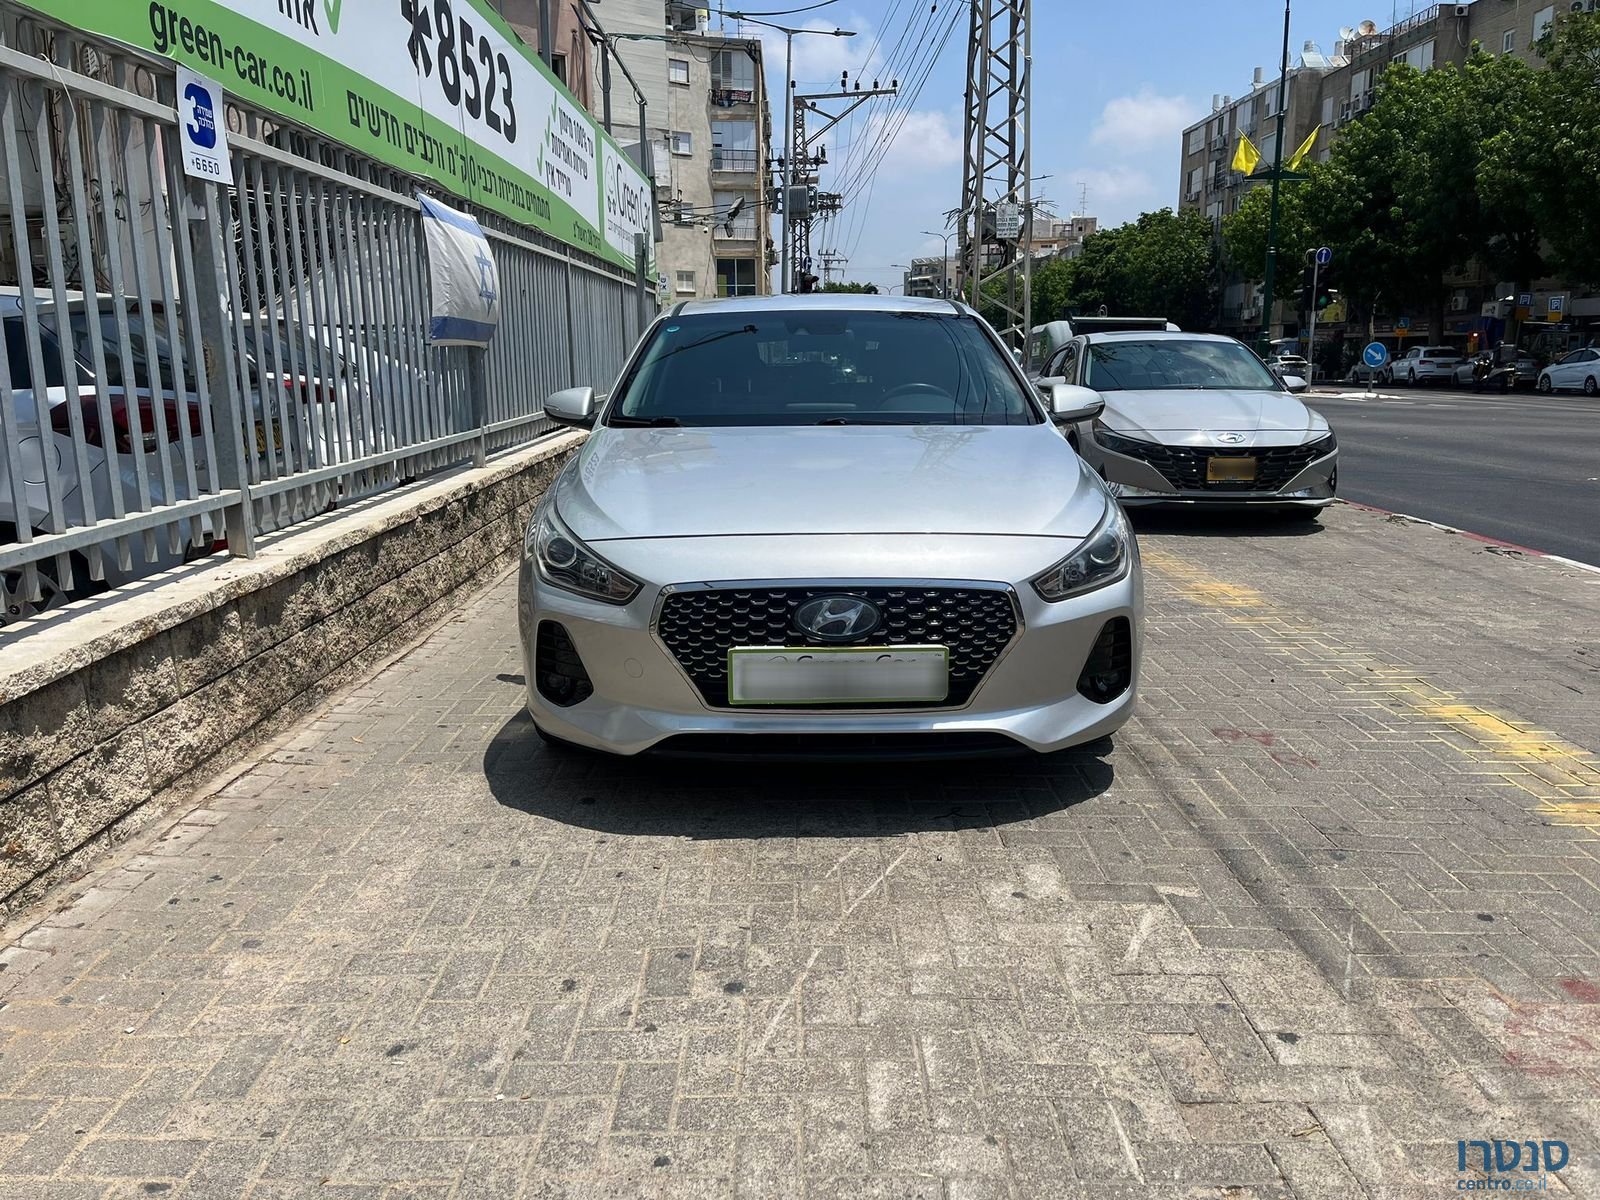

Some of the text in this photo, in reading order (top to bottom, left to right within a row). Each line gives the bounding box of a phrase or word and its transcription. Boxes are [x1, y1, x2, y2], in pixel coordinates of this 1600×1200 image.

[150, 1, 314, 111] green-car.co.il
[347, 89, 402, 149] חדשים
[404, 122, 446, 171] ורכבים
[572, 150, 588, 181] שירות
[478, 164, 498, 197] רכבי
[498, 176, 525, 209] במכירת
[545, 160, 572, 197] טרייד אין
[617, 163, 641, 230] Green
